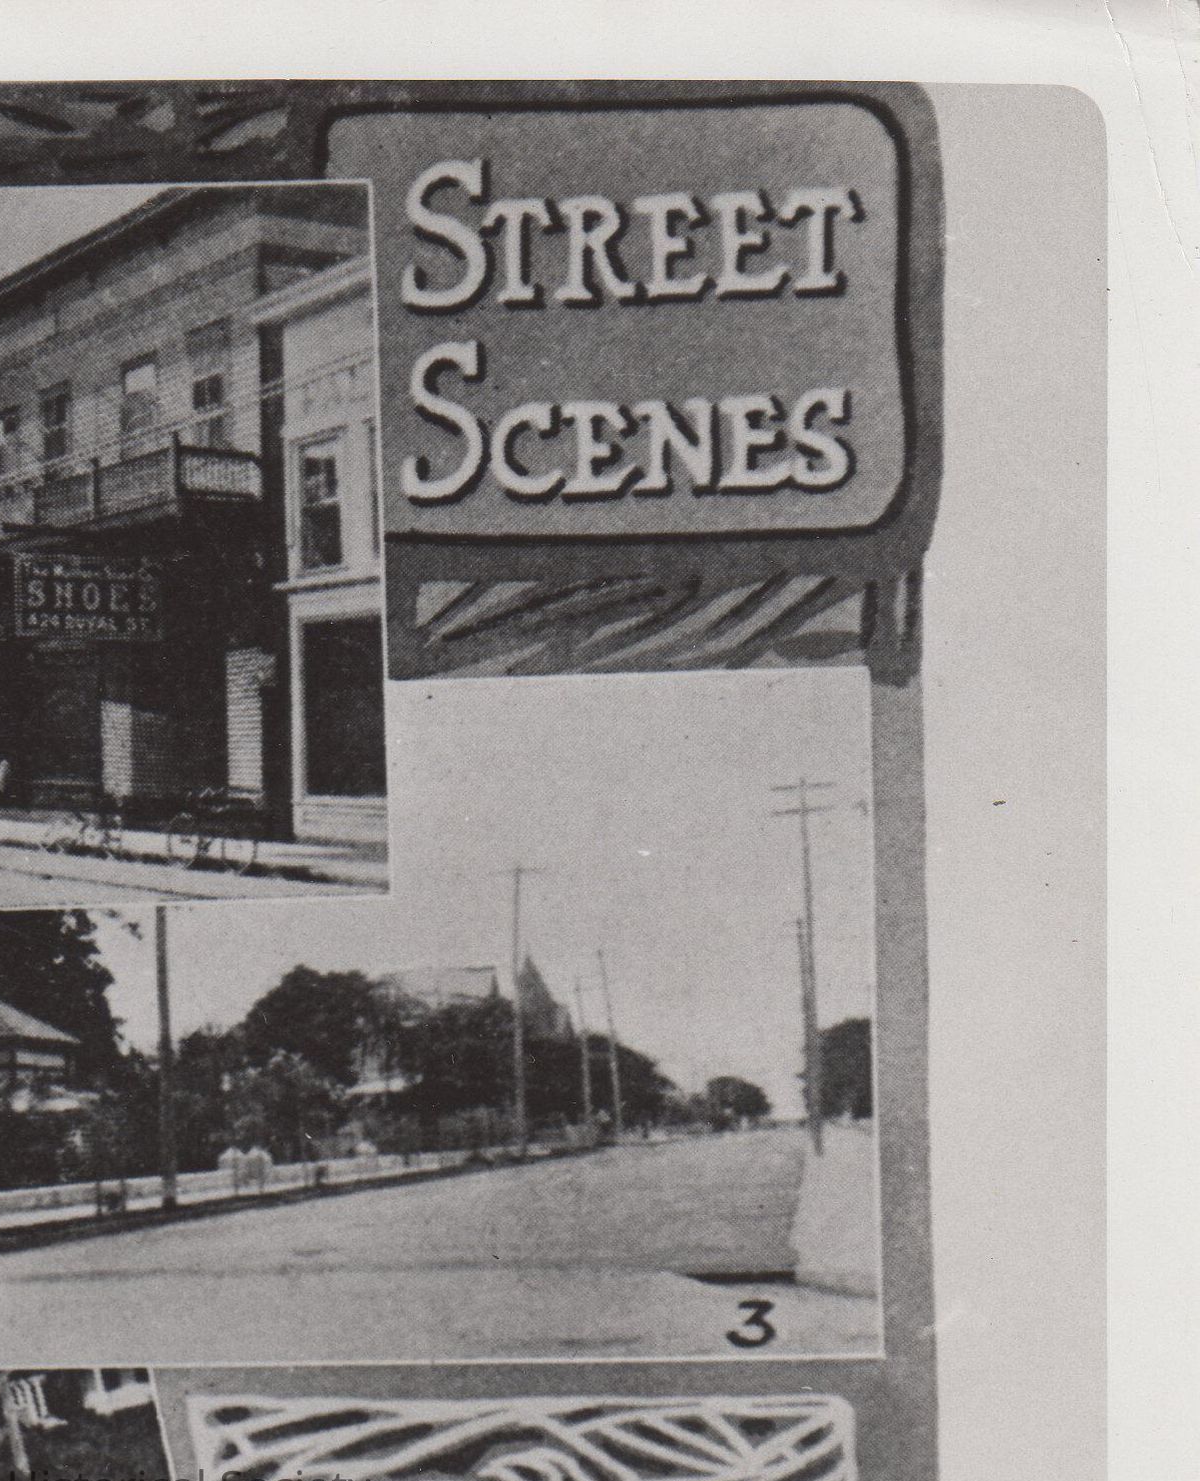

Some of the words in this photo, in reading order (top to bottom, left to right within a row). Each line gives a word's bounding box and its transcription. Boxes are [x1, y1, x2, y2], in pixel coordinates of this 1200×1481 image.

[402, 158, 864, 314] STREET
[402, 340, 855, 504] SCENES
[26, 579, 157, 613] SHOES
[727, 1298, 776, 1349] 3
